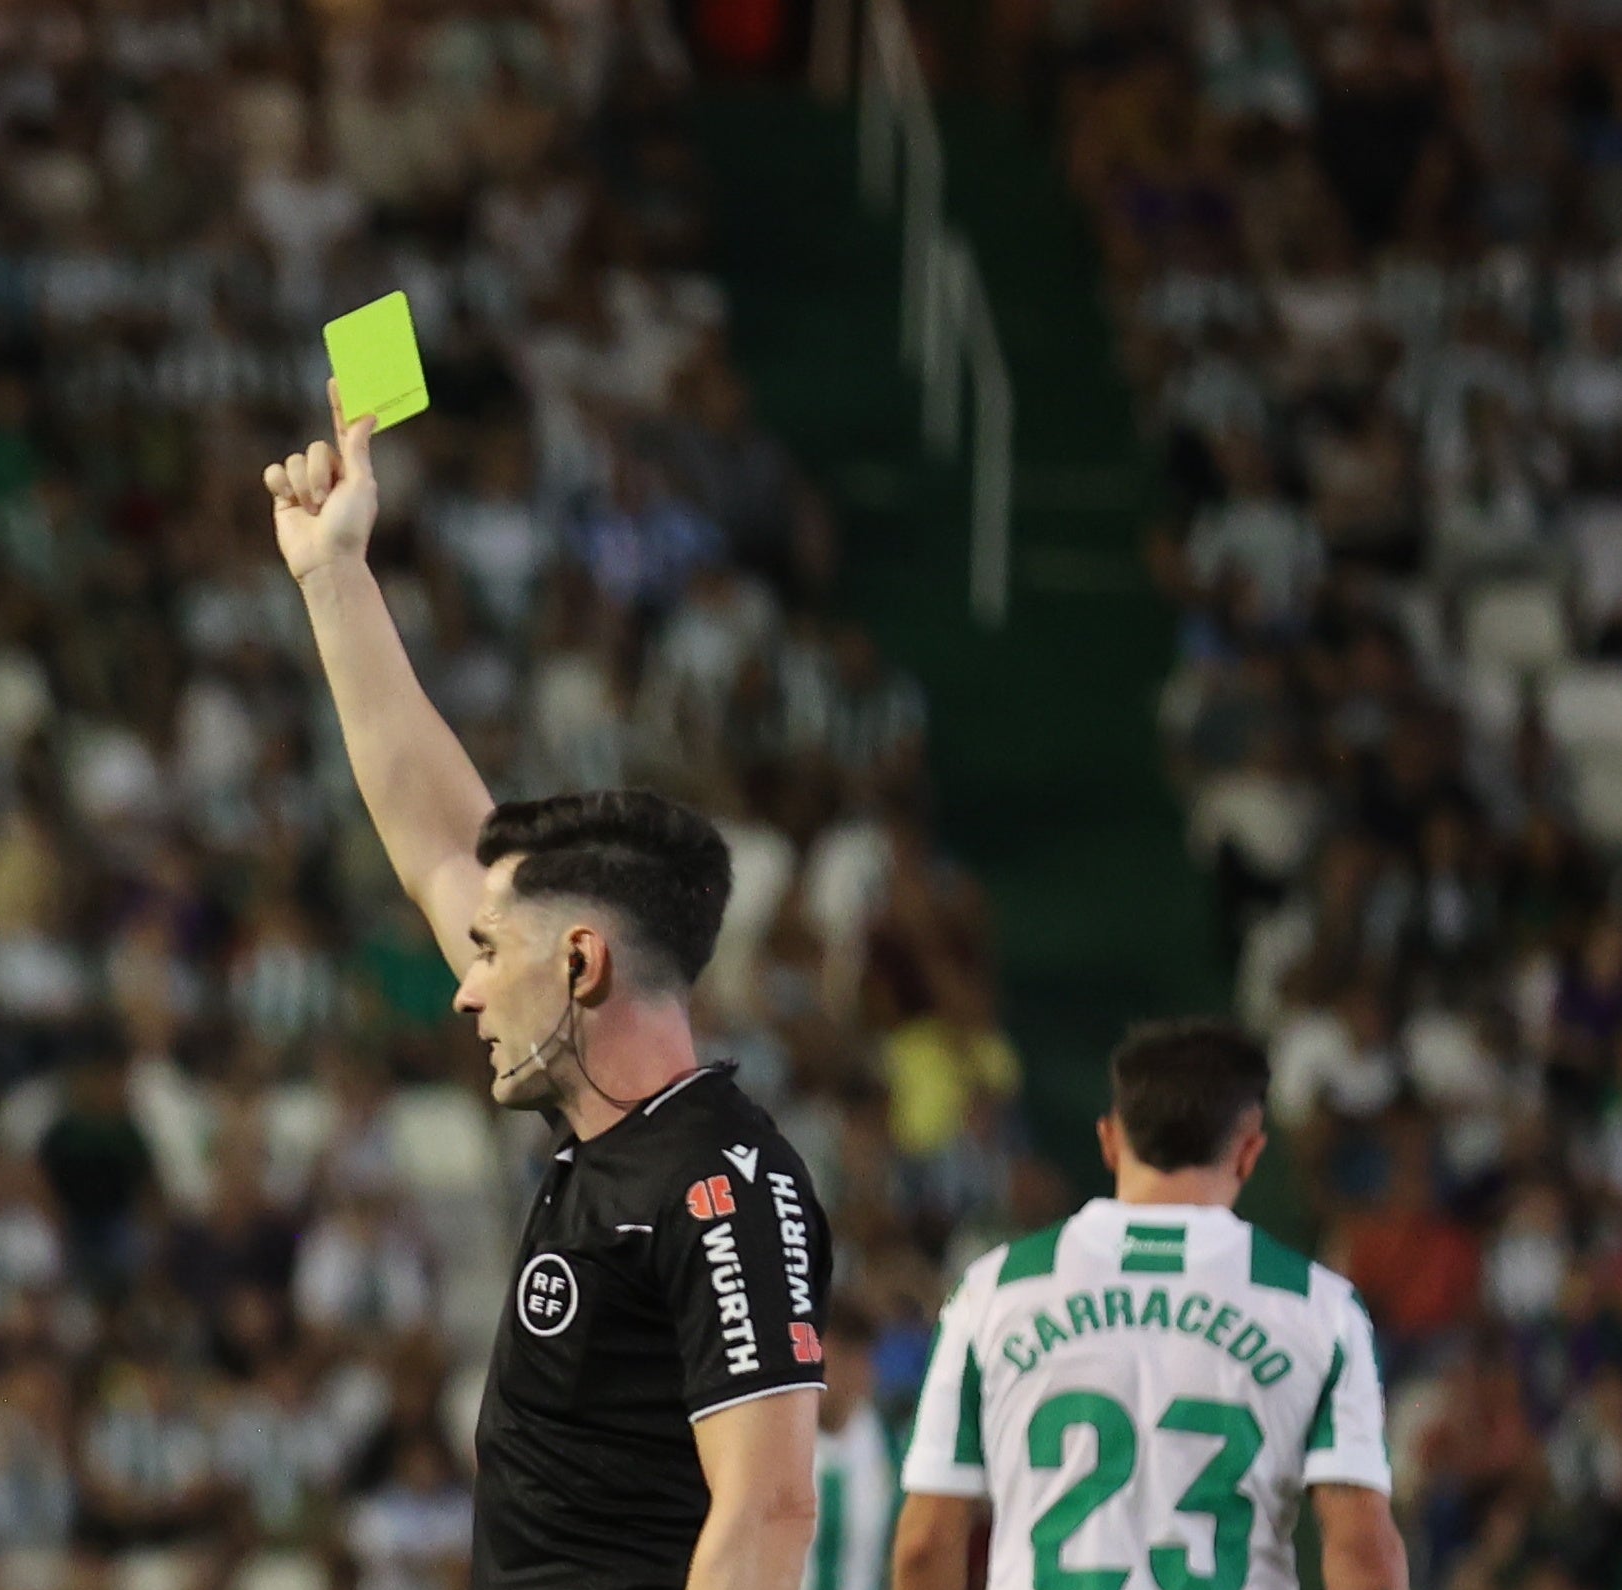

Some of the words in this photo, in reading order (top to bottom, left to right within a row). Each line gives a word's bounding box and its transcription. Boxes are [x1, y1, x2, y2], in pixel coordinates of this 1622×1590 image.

[701, 1221, 760, 1376] WÜRTH
[766, 1171, 813, 1317] WÜRTH
[1002, 1284, 1294, 1388] CARRACEDO
